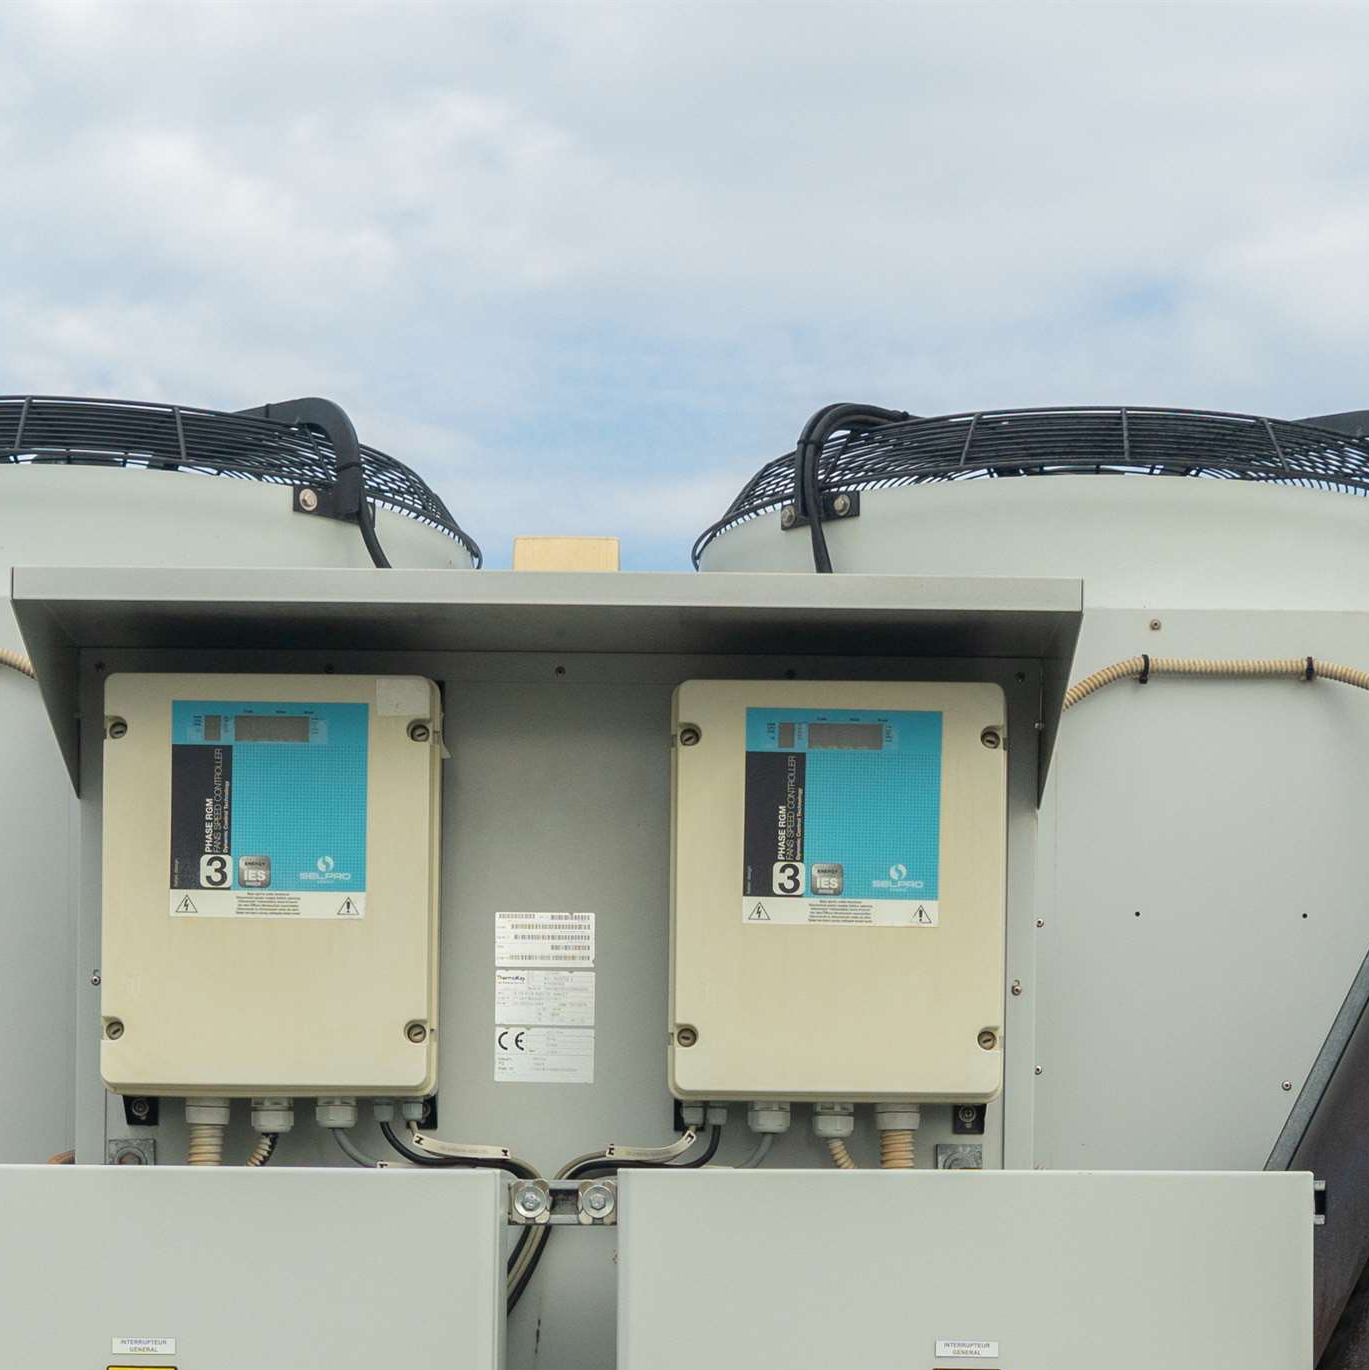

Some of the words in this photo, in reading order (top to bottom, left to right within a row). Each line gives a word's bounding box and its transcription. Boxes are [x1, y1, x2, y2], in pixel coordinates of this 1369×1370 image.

[214, 748, 222, 802] CONTROLLER
[787, 755, 796, 809] CONTROLLER
[205, 798, 213, 821] RGM
[213, 803, 222, 830] SPEED
[778, 805, 786, 828] RGM
[204, 822, 213, 853] PHASE
[786, 811, 795, 838] SPEED
[213, 832, 221, 853] FANS
[777, 829, 786, 861] PHASE
[786, 839, 794, 860] FANS
[206, 856, 228, 887] 3
[243, 869, 267, 881] IES
[778, 863, 800, 894] 3
[816, 877, 839, 889] IES
